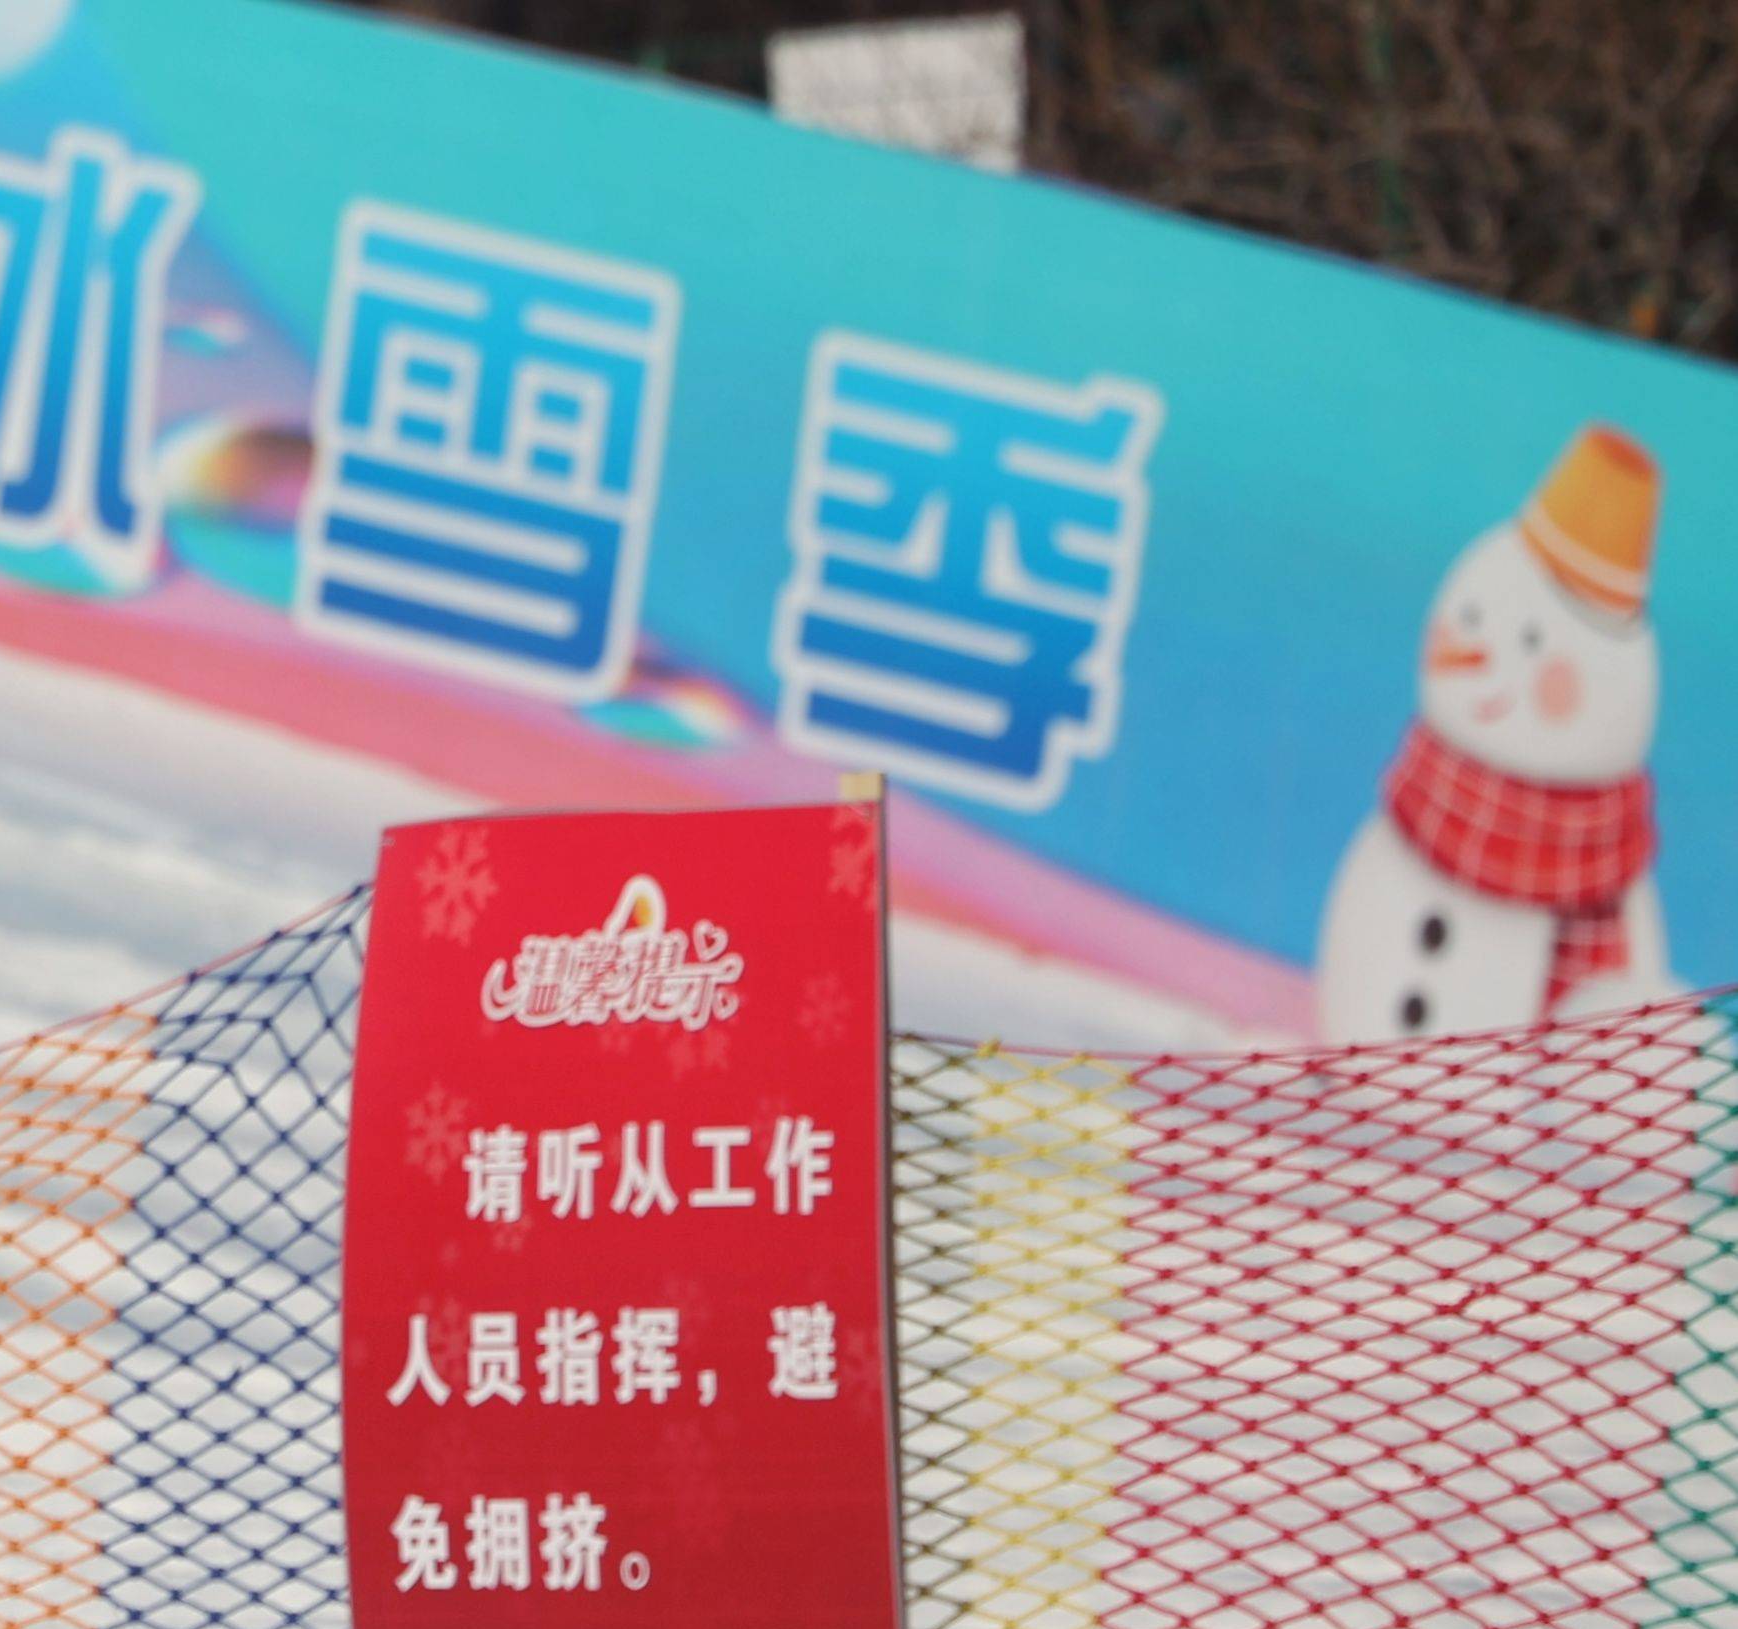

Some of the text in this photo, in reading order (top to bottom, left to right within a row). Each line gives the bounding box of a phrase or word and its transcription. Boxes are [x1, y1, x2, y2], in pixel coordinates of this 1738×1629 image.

[462, 1115, 835, 1223] 请听从工作
[386, 1302, 838, 1406] 人员指挥，避
[391, 1492, 651, 1592] 免拥挤。
